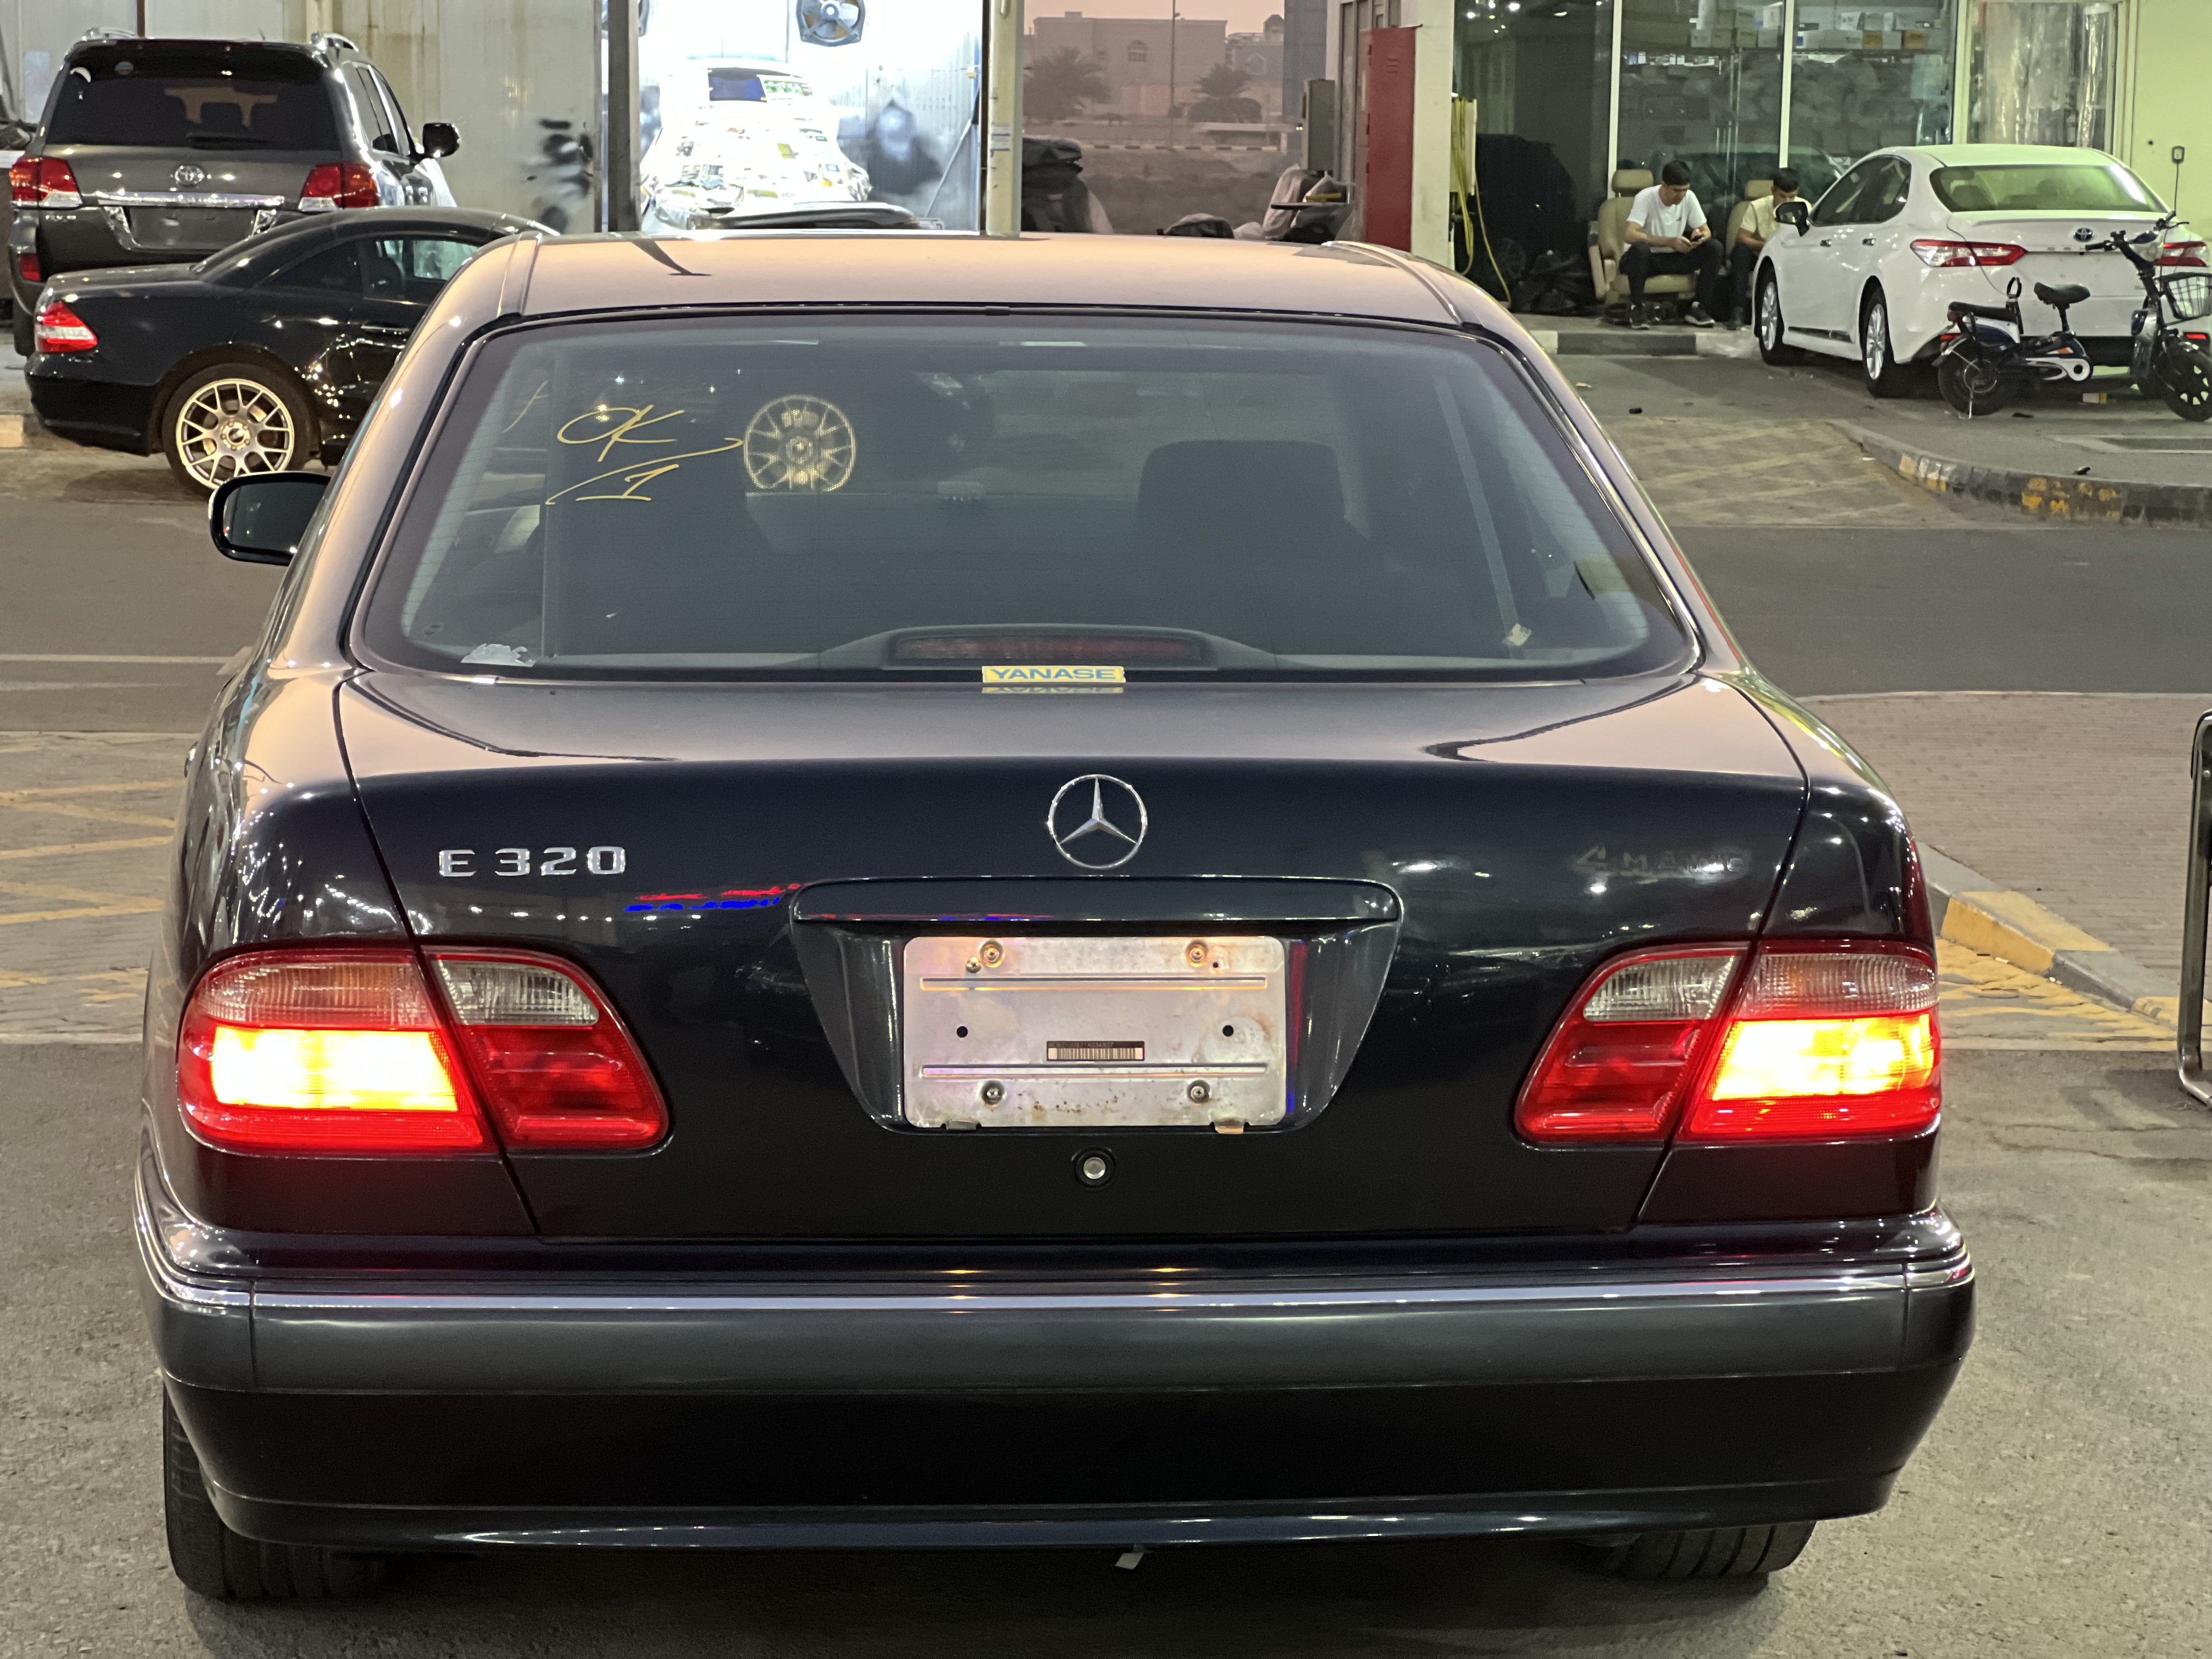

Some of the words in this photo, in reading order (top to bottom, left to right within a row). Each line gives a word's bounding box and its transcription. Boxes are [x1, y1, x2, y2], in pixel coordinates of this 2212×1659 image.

[557, 404, 685, 462] OK
[991, 668, 1116, 679] YANASE
[439, 849, 476, 877] E
[494, 846, 626, 876] 320
